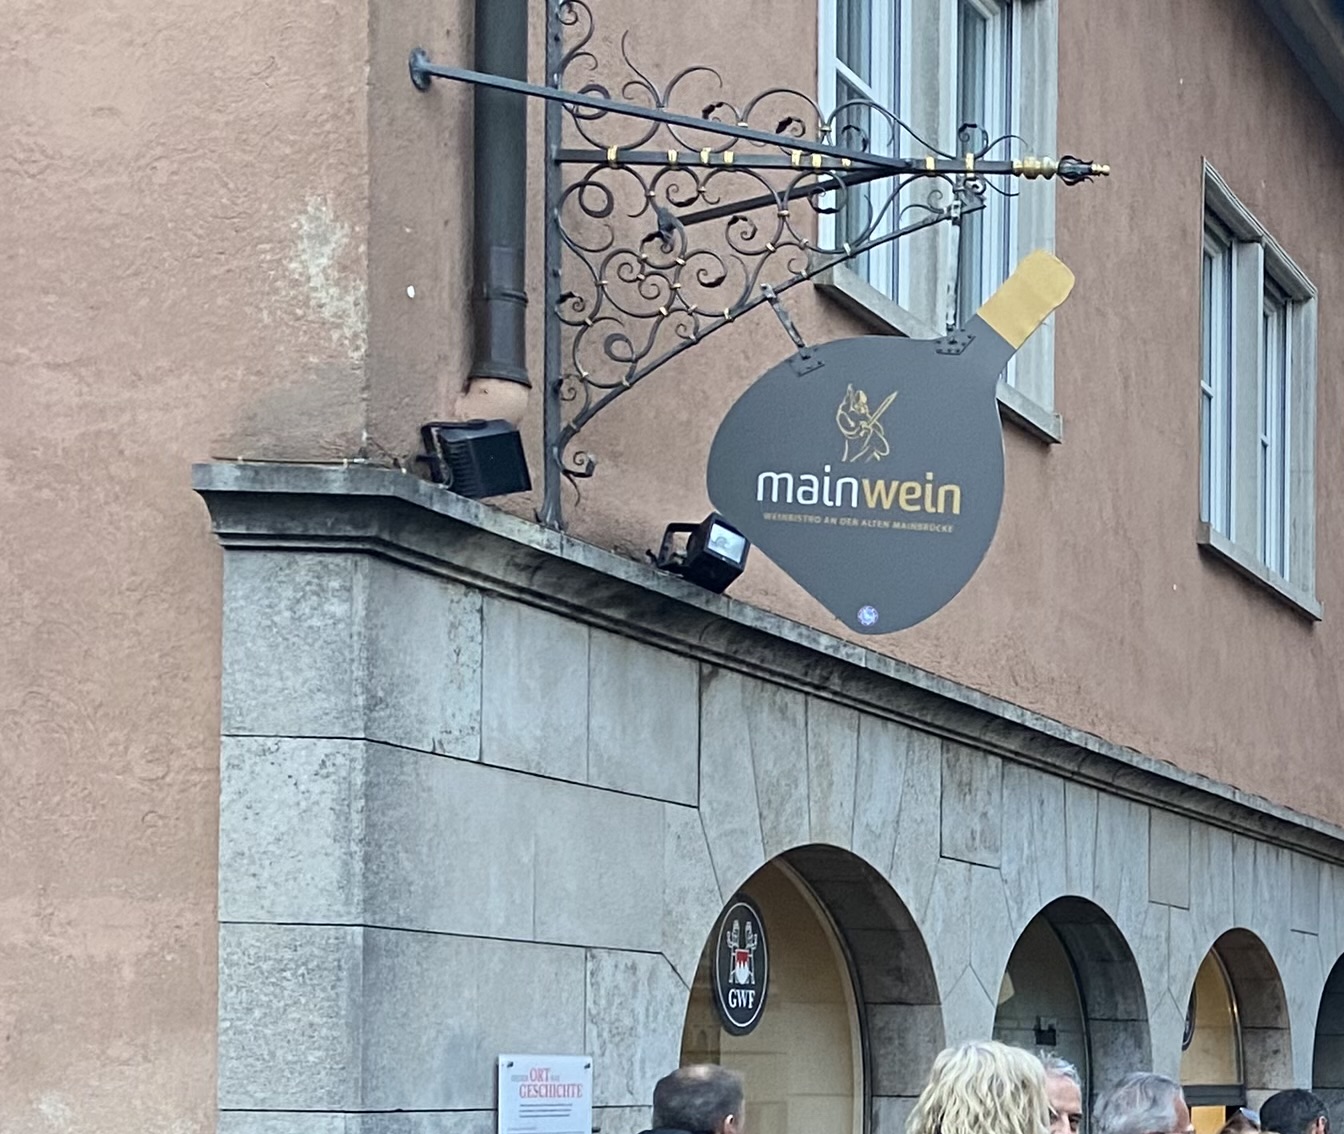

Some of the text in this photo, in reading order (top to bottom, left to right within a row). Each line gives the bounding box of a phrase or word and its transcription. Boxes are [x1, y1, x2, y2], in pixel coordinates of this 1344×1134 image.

[757, 465, 961, 515] mainwein
[823, 517, 837, 525] AN
[839, 517, 859, 527] DER
[860, 519, 890, 529] ALTEN
[728, 988, 756, 1009] GWF
[529, 1067, 551, 1082] ORT
[519, 1083, 583, 1098] GESCHICHTE
